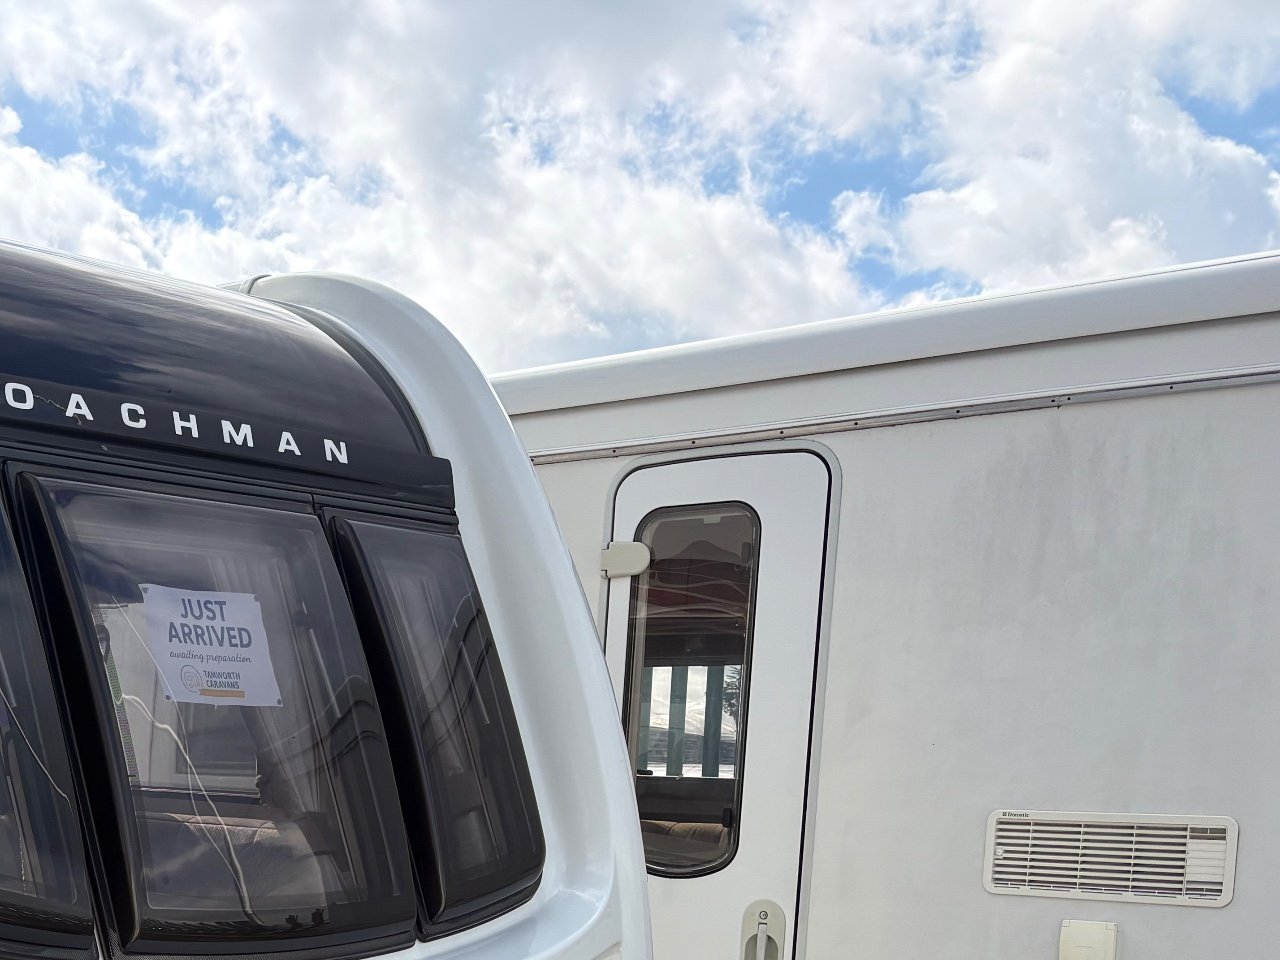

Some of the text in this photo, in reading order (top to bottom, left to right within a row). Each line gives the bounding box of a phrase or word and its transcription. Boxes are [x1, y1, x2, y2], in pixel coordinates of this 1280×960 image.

[180, 598, 227, 622] JUST
[168, 621, 253, 648] ARRIVED
[169, 650, 252, 664] awaiting preparation
[203, 670, 240, 680] TAMWORTH
[206, 680, 239, 689] CARAVANS
